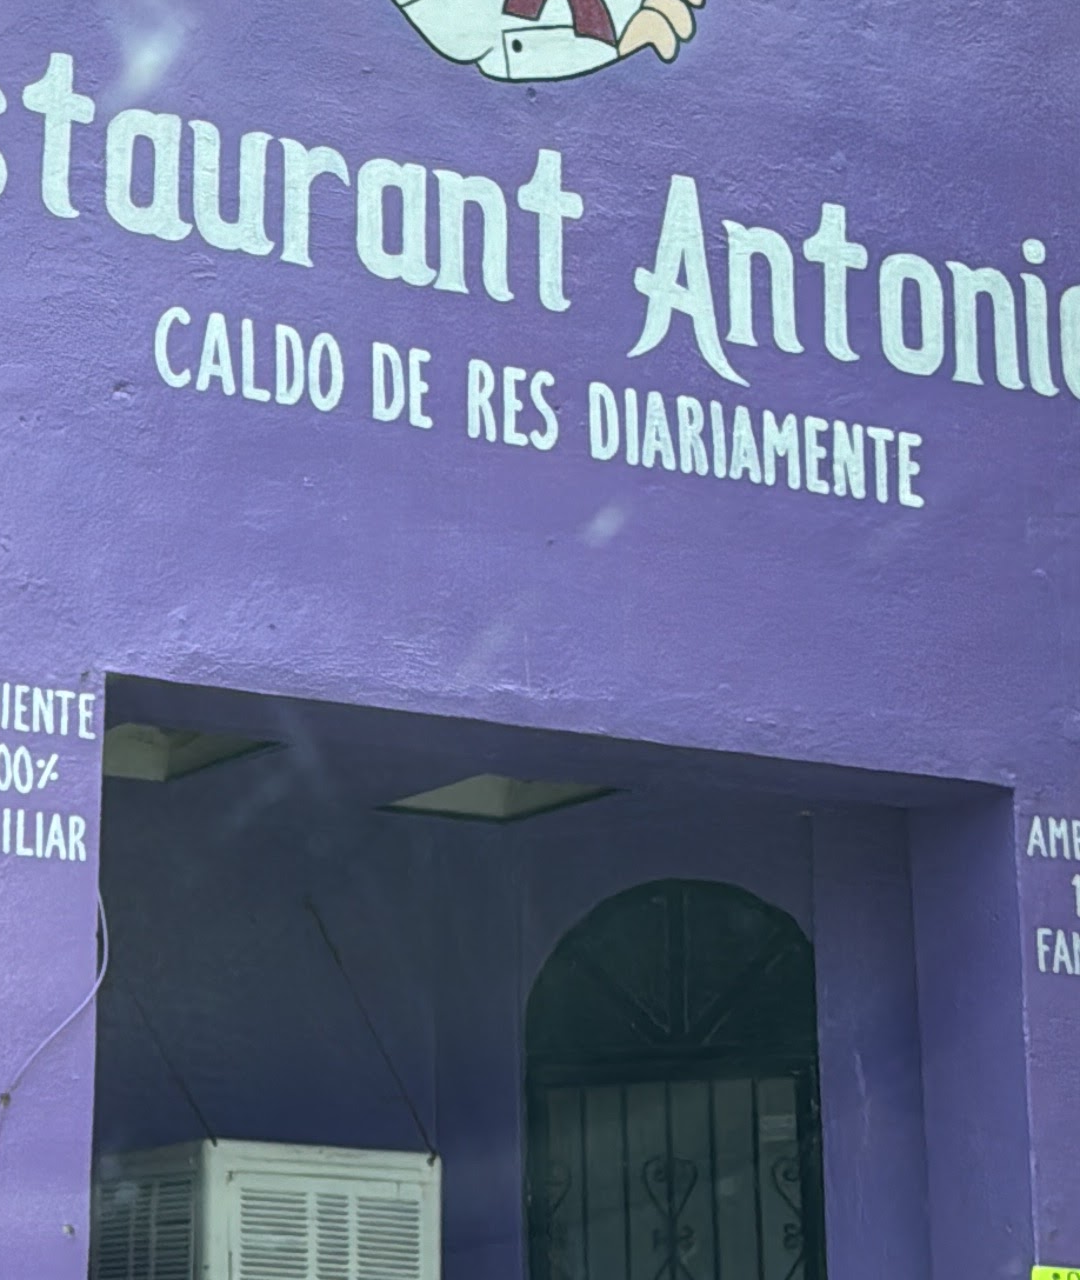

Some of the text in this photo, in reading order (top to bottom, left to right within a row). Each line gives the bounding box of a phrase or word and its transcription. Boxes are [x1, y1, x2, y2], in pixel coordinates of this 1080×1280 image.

[154, 306, 926, 508] CALDO DE RES DIARIAMENTE
